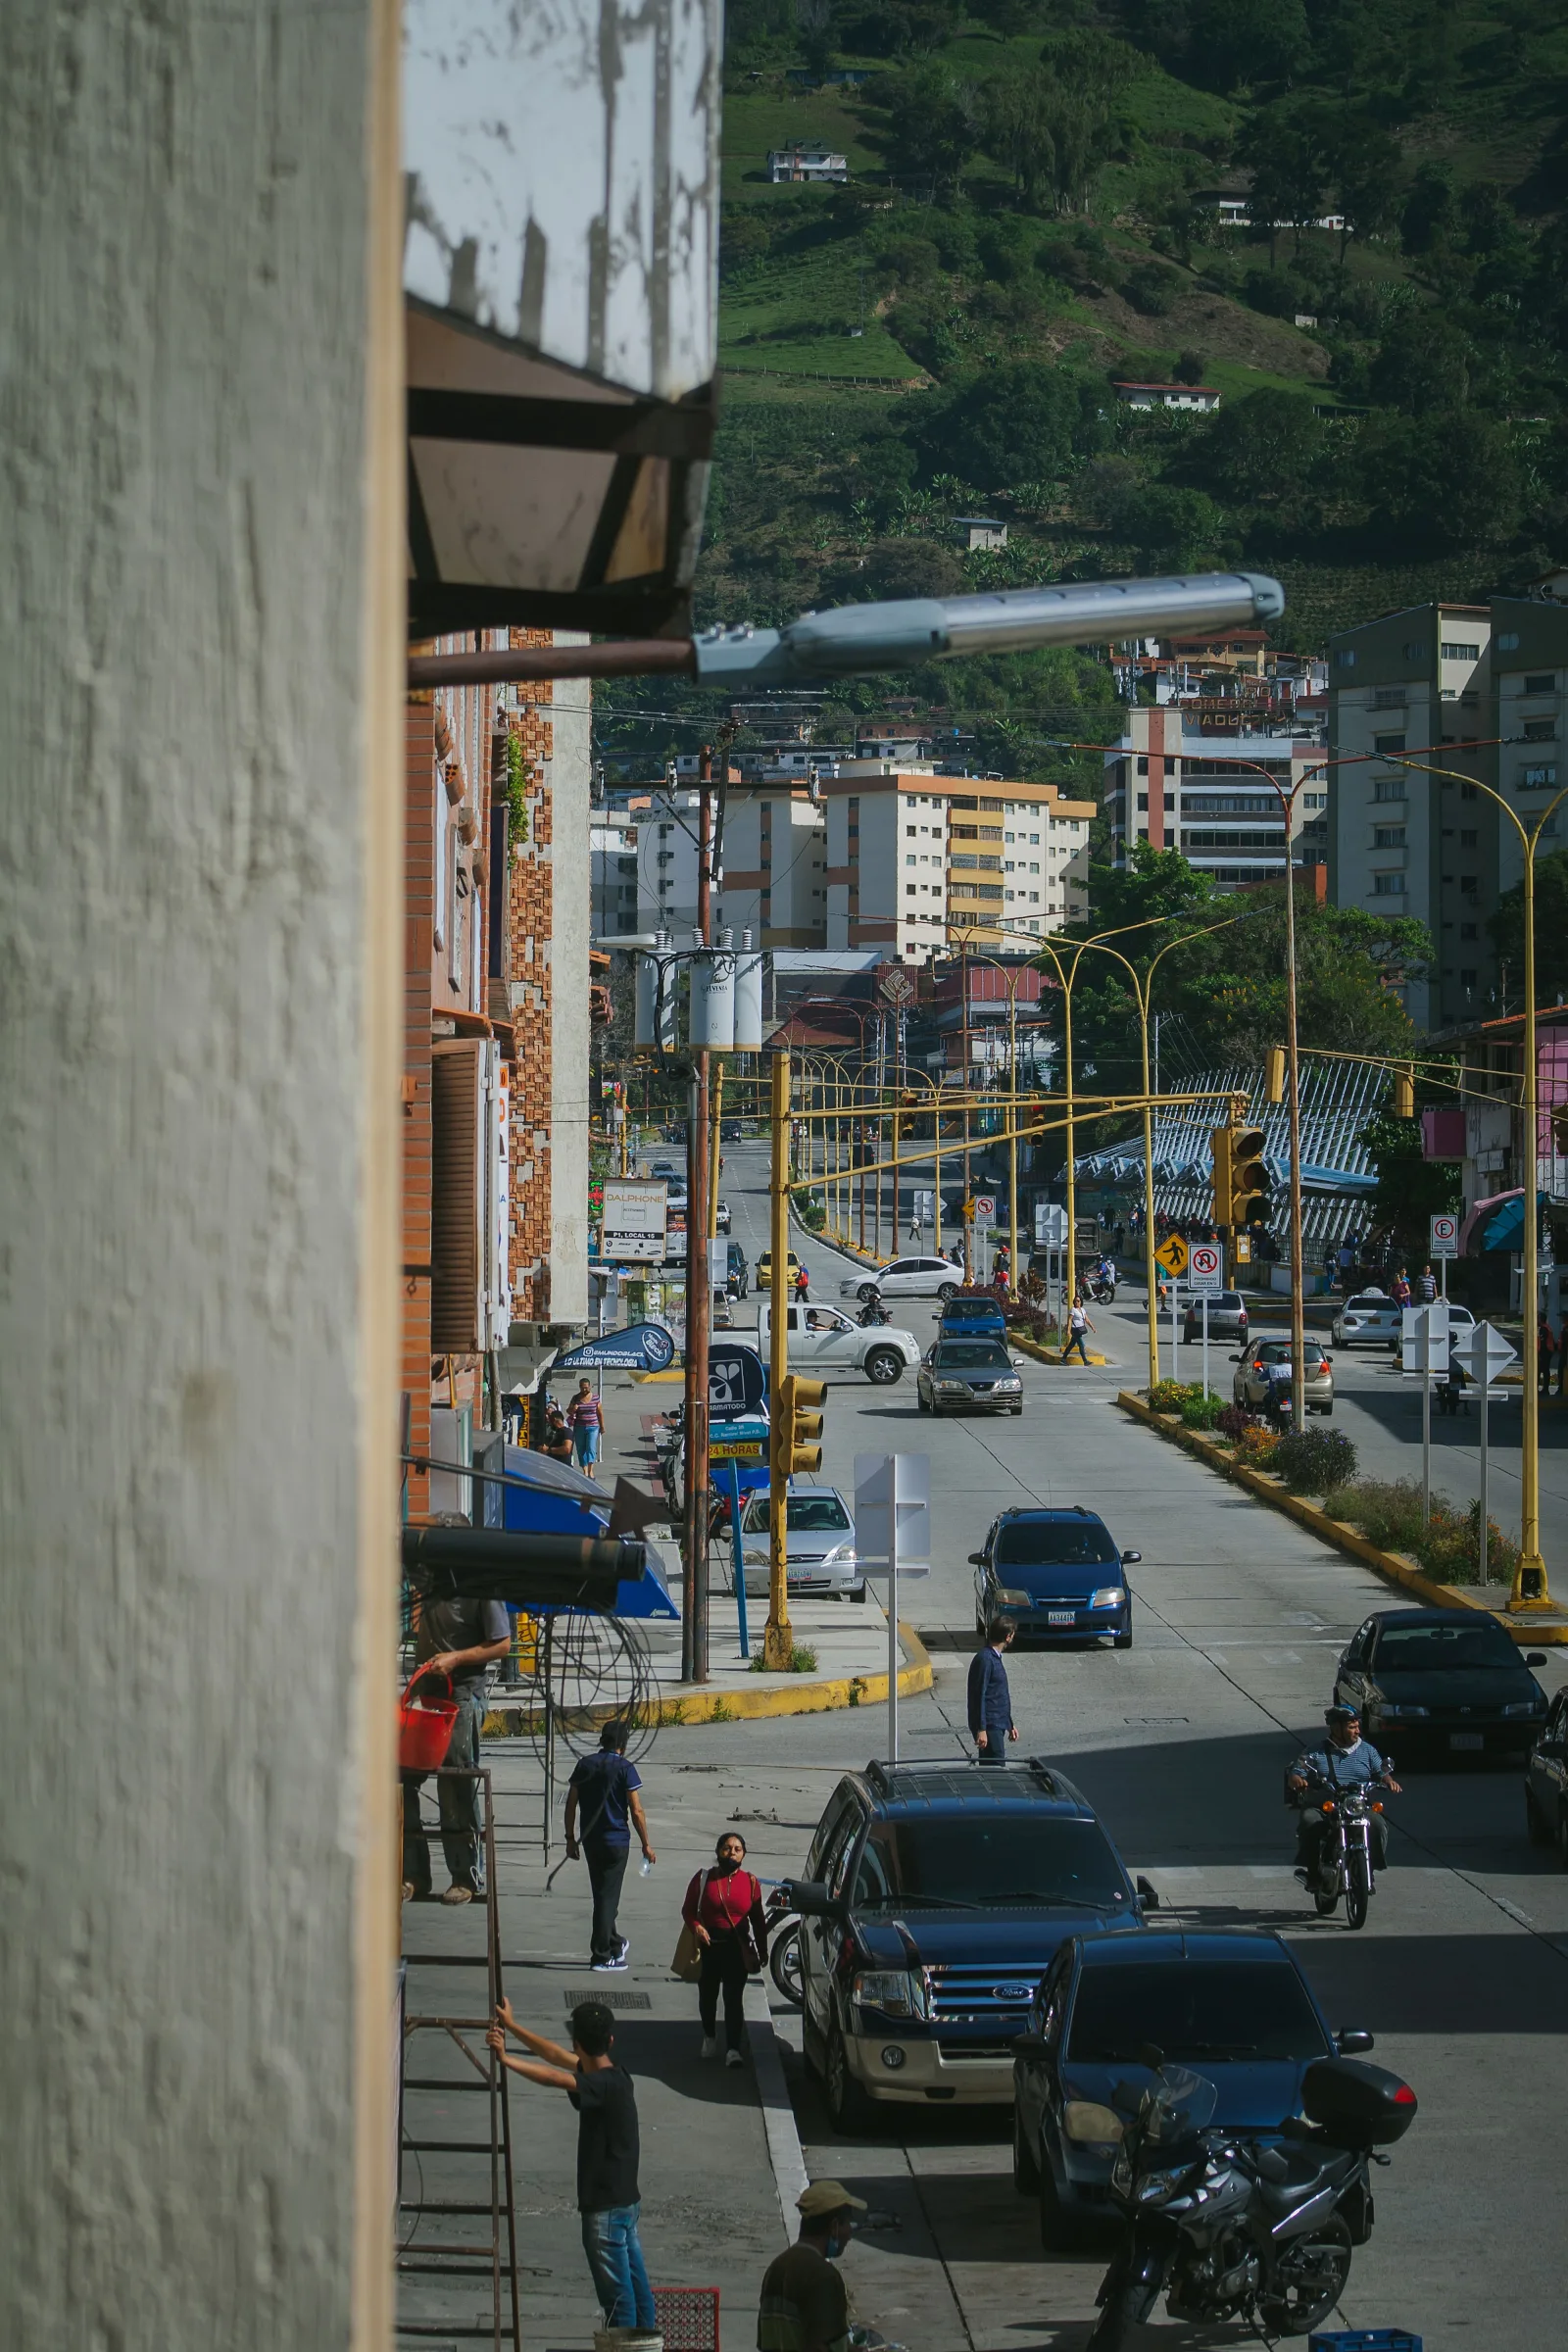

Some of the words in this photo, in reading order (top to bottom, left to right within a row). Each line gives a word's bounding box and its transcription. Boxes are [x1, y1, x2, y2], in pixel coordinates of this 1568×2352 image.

[607, 1194, 664, 1203] DALPHONE
[1440, 1223, 1447, 1235] E
[710, 1402, 746, 1411] ARMATODO
[723, 1445, 760, 1455] HORAS
